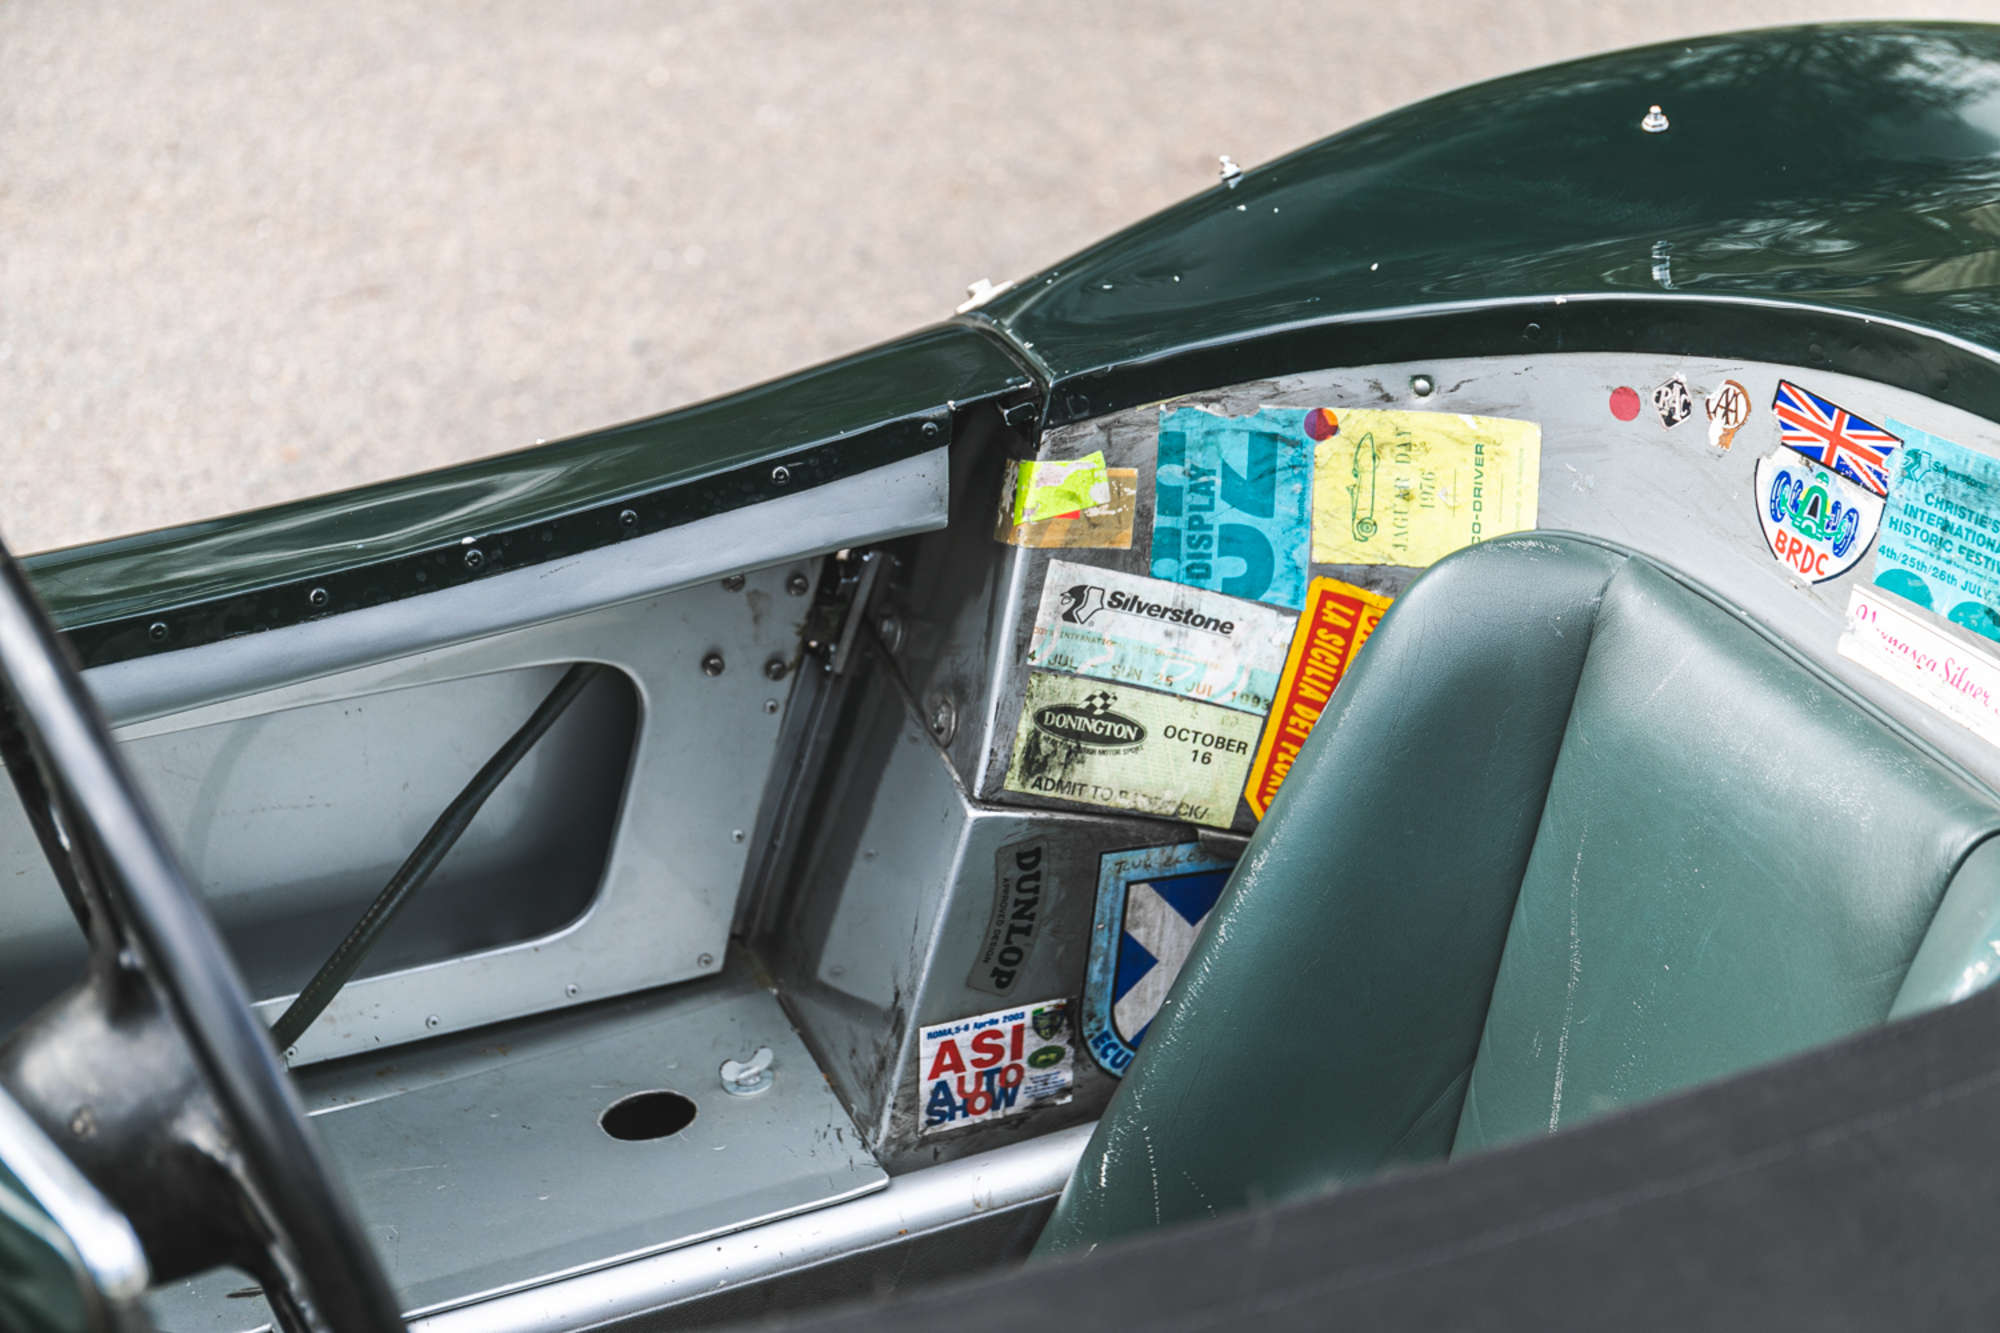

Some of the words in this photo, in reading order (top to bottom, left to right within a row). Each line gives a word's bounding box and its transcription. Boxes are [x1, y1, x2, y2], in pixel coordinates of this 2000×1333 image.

[1395, 428, 1412, 464] DAY
[1419, 471, 1436, 509] 1976
[1472, 443, 1485, 544] CO-DRIVER
[1185, 463, 1217, 580] DISPLAY
[1392, 477, 1410, 552] JAGUAR
[1924, 492, 2000, 534] CHRISTIE'S
[1774, 529, 1829, 577] BRDC
[1888, 516, 1953, 553] HISTORIC
[1106, 590, 1235, 636] Silverstone
[1321, 600, 1356, 630] LA
[1048, 654, 1078, 669] JUL
[1112, 664, 1142, 681] SUN
[1297, 627, 1346, 702] SICILIA
[1944, 657, 1991, 707] Silver
[1043, 710, 1139, 742] DONINGTON
[1163, 725, 1249, 755] OCTOBER
[1285, 702, 1321, 740] DEI
[1191, 750, 1213, 765] 16
[1031, 776, 1087, 798] ADMIT
[1092, 785, 1113, 801] TO
[989, 847, 1042, 989] DUNLOP
[996, 878, 1010, 926] APPROVED
[982, 928, 1001, 964] DESIGN
[972, 1018, 999, 1030] Aprile
[927, 1023, 1025, 1081] ASI
[925, 1084, 1020, 1126] SHOW
[928, 1063, 1024, 1108] AUTO
